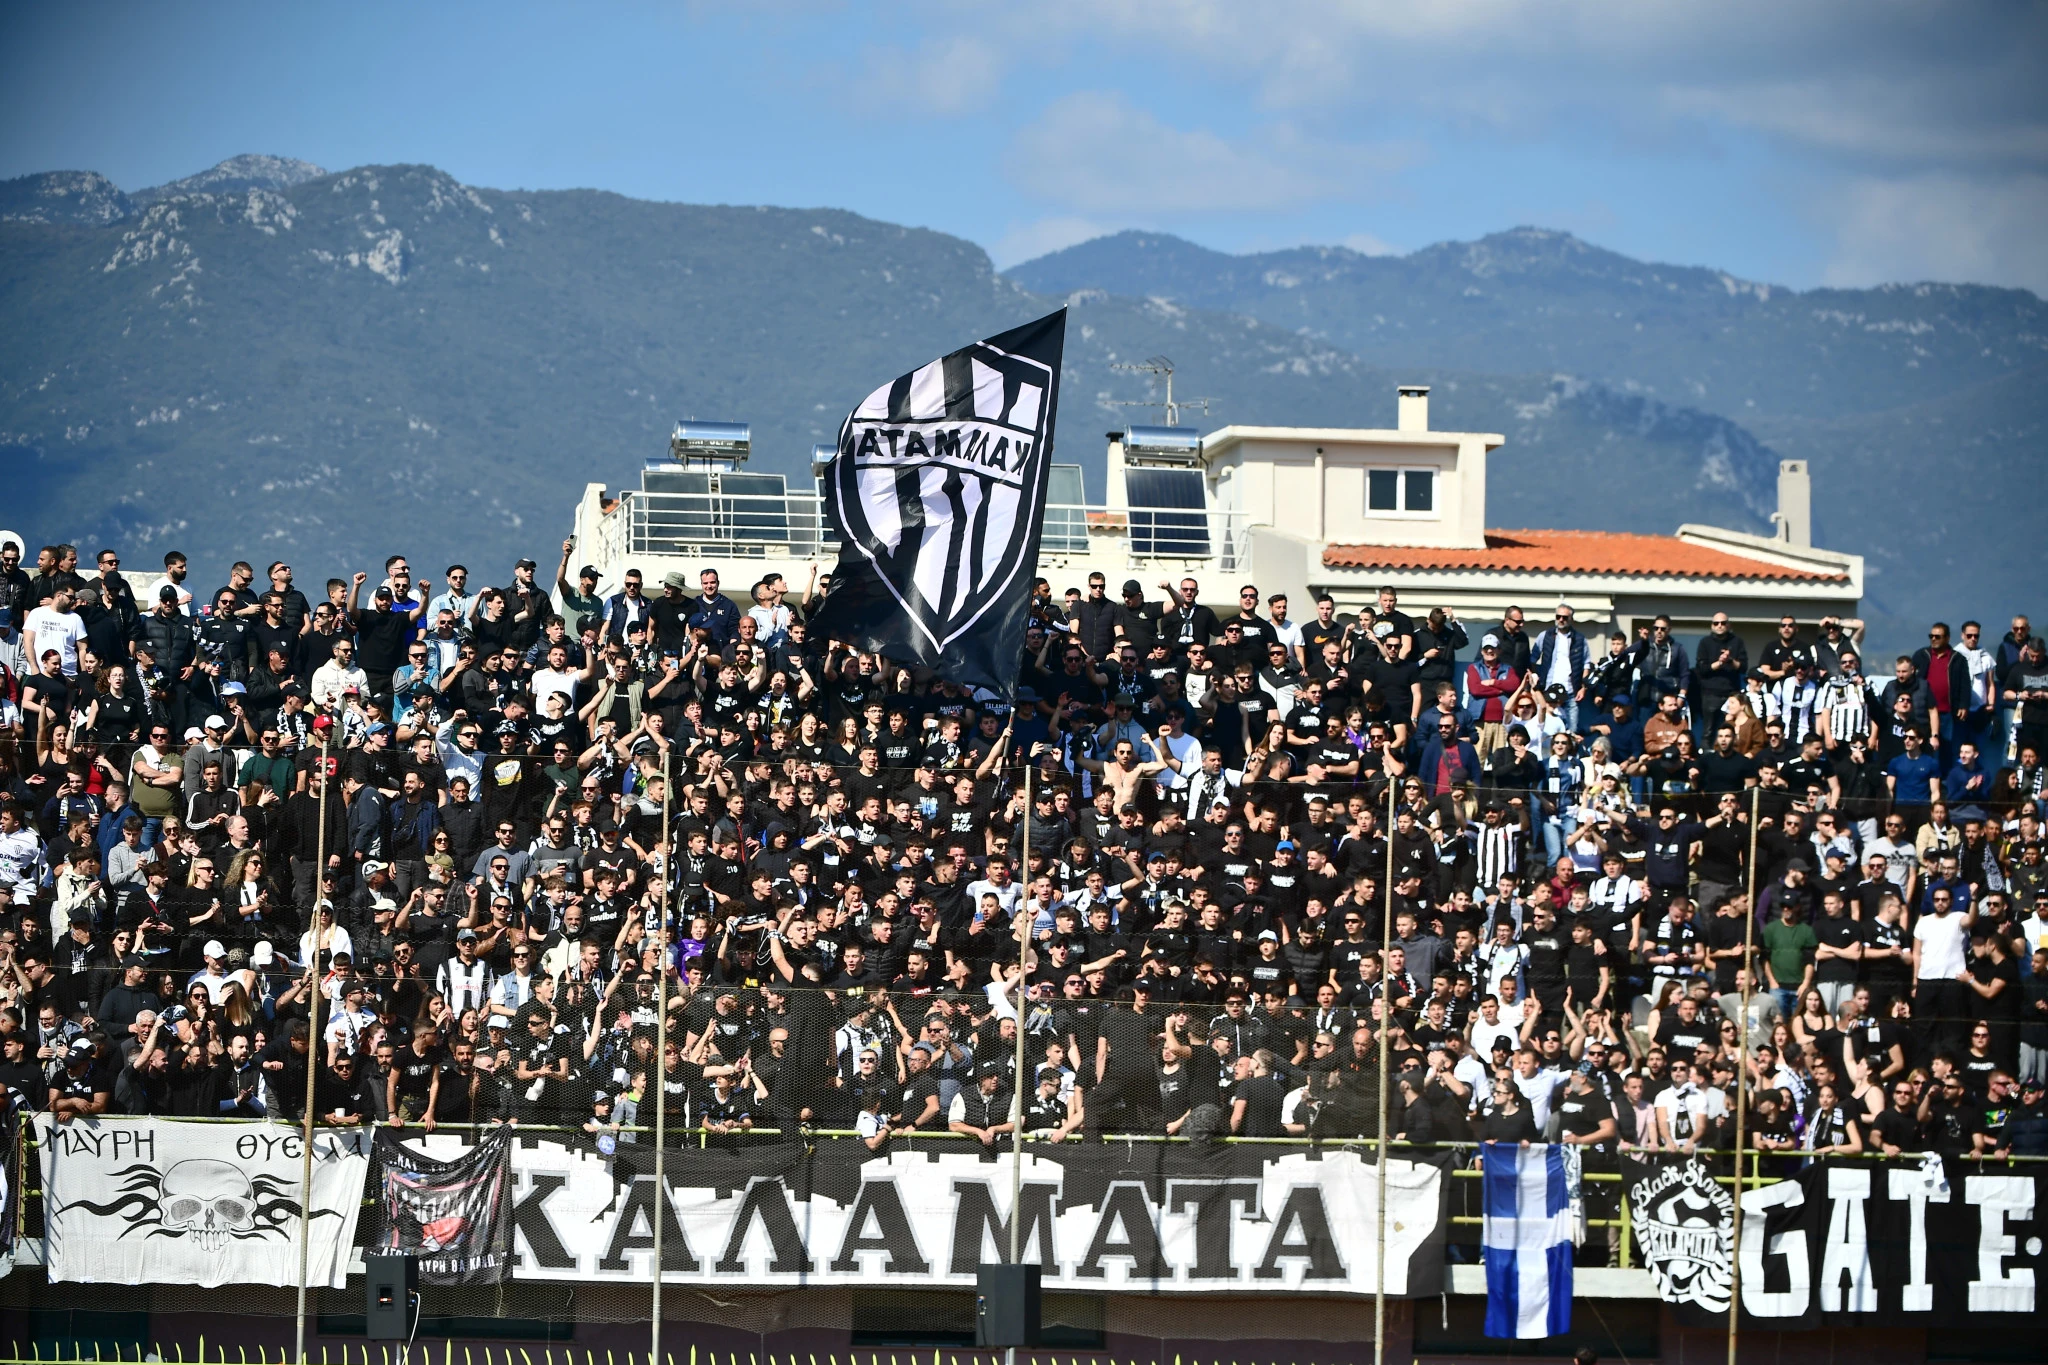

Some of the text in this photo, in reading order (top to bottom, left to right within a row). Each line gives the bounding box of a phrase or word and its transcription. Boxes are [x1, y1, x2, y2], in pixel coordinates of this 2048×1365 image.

[589, 911, 618, 923] novibet
[44, 1125, 368, 1163] ΜΑΥΡΗ ΘΥΕΛΑ
[1631, 1166, 1682, 1208] Black
